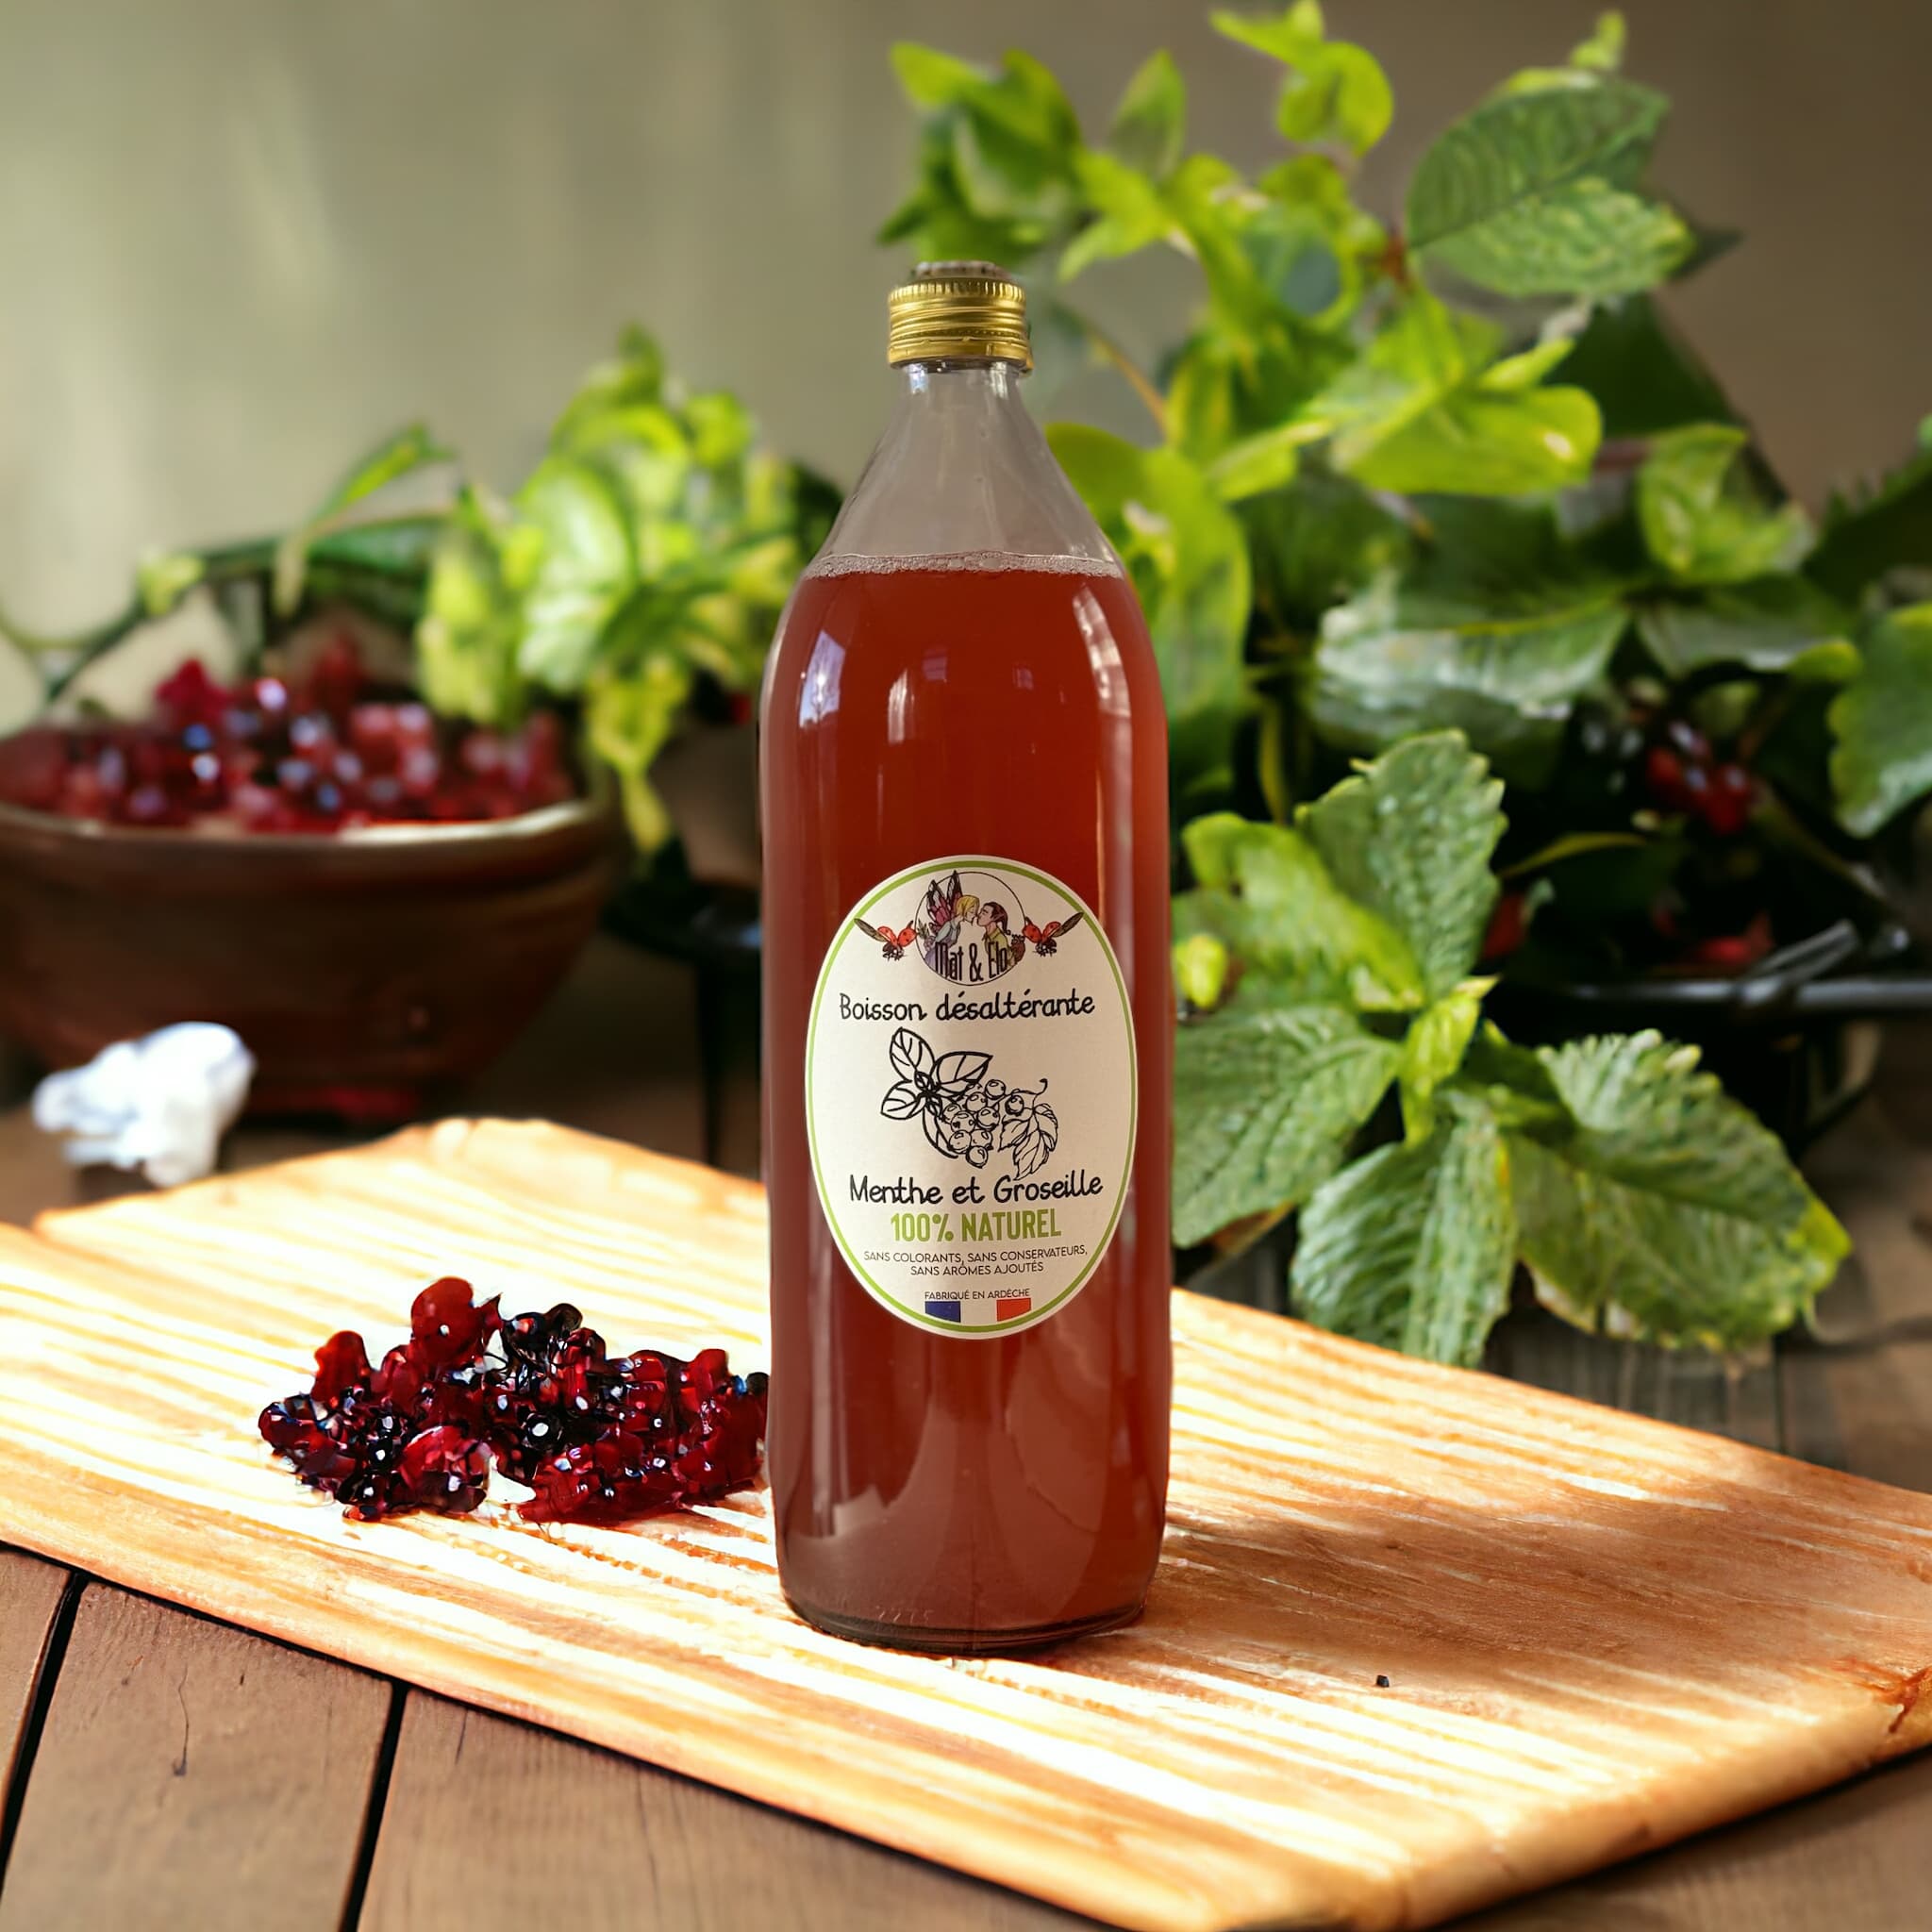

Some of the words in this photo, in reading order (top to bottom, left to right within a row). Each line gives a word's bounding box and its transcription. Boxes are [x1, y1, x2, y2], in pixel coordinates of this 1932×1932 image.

[935, 941, 963, 981] Mat
[969, 942, 984, 982] &
[988, 941, 1007, 978] Elo
[840, 992, 927, 1021] Boisson
[935, 989, 1095, 1021] désaltérante
[849, 1174, 943, 1205] Menthe
[952, 1176, 985, 1204] et
[993, 1169, 1104, 1204] Groseille
[891, 1212, 955, 1242] 100%
[961, 1208, 1061, 1242] NATUREL
[863, 1251, 891, 1261] SANS
[892, 1252, 965, 1265] COLORANTS,
[967, 1251, 997, 1262] SANS
[1000, 1244, 1088, 1261] CONSERVATEURS,
[910, 1265, 940, 1275] SANS
[993, 1260, 1043, 1274] AJOUTÉS
[924, 1289, 970, 1300] FABRIQUÉ
[972, 1291, 985, 1299] EN
